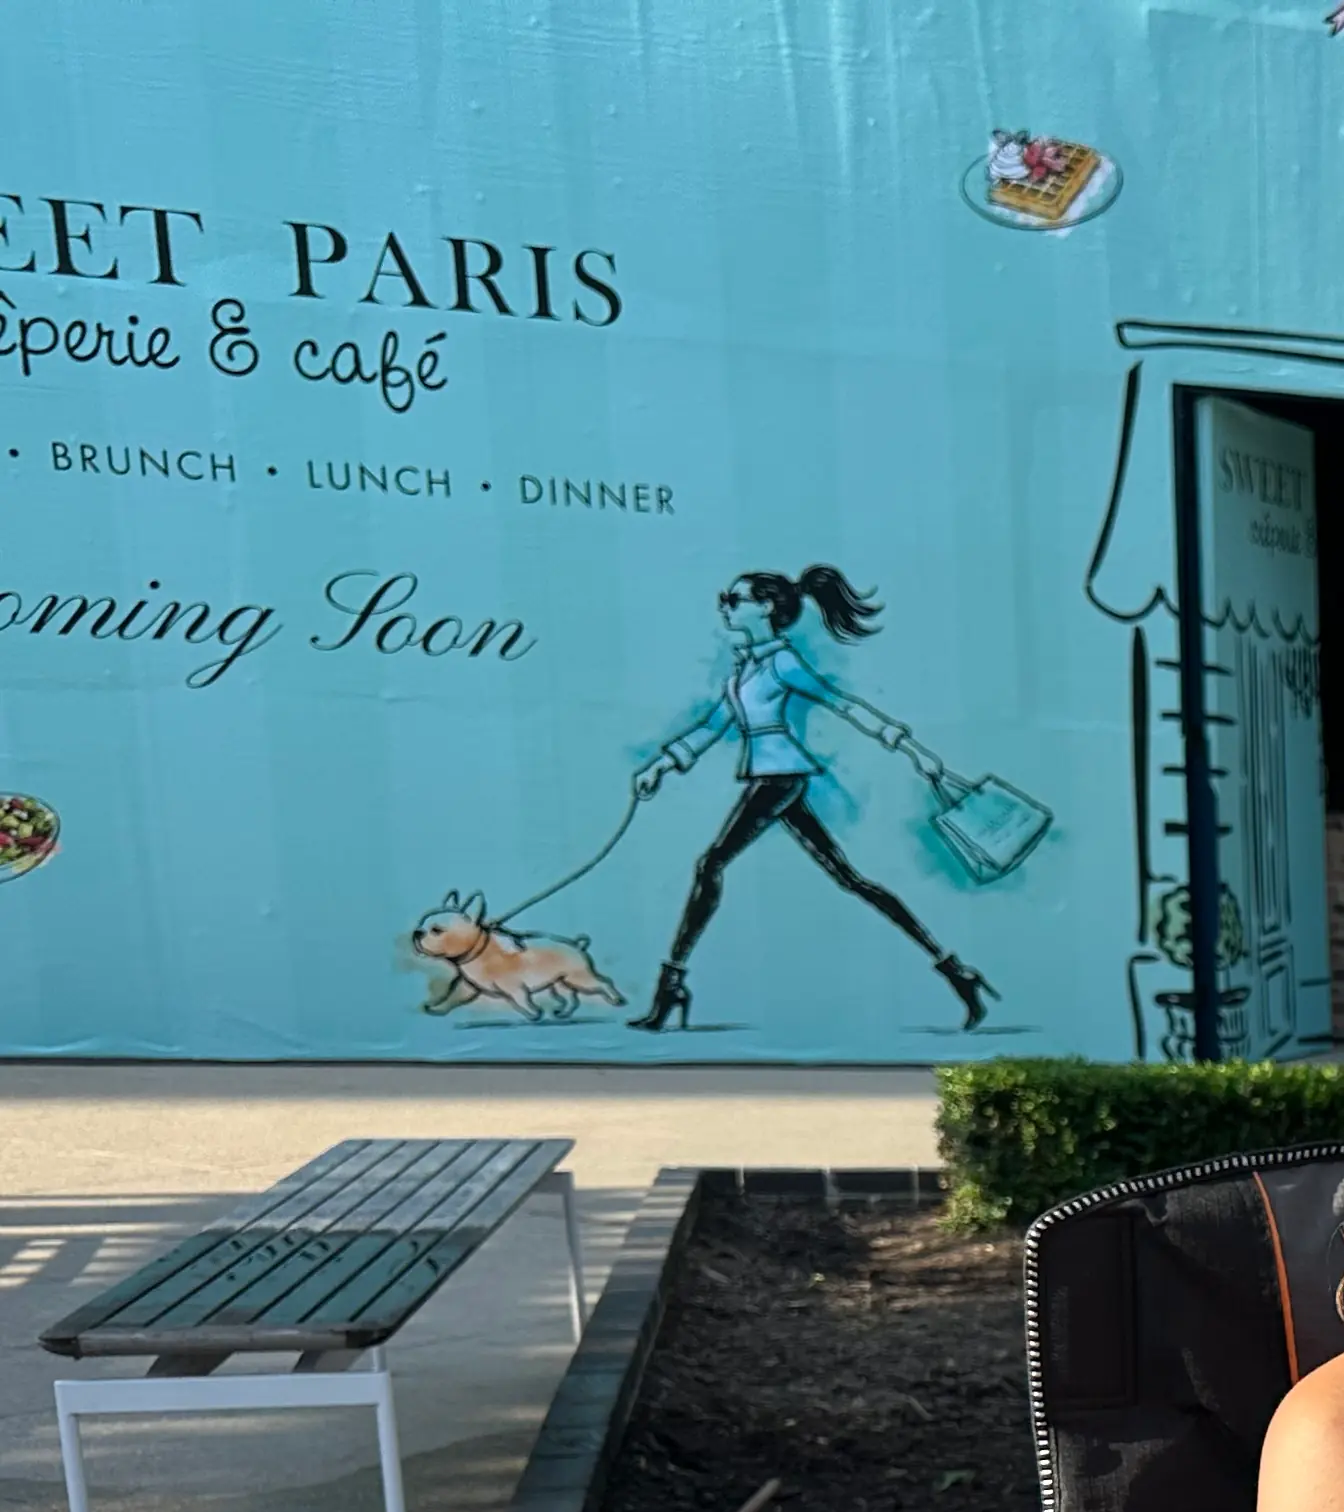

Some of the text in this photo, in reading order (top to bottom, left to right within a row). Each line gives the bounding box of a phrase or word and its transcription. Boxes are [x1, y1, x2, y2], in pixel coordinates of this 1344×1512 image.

[283, 220, 623, 327] PARIS
[208, 298, 259, 376] &
[294, 331, 448, 413] café
[51, 441, 675, 515] BRUNCH LUNCH DINNER
[310, 568, 539, 662] Soon
